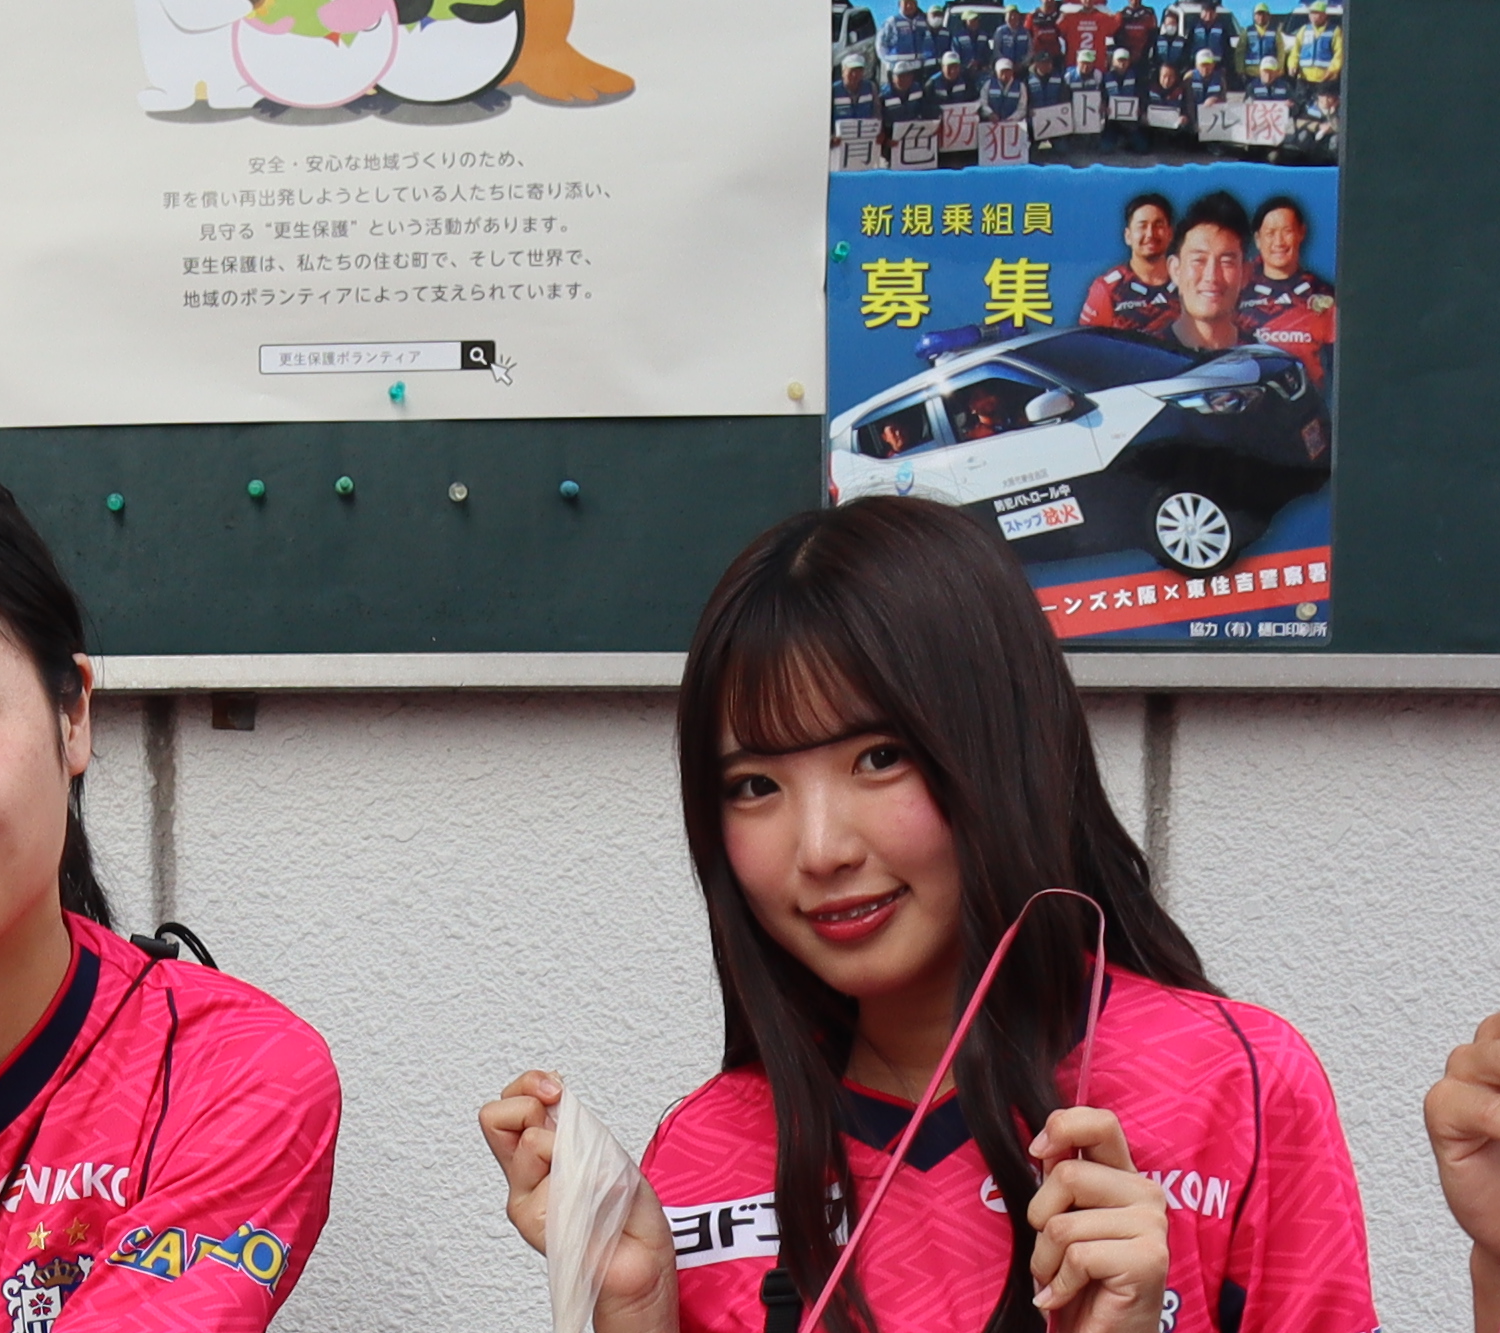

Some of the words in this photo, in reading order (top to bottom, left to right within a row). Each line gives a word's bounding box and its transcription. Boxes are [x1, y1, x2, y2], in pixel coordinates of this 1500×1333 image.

[248, 149, 527, 175] 安全・安心な地域づくりのため、
[162, 180, 613, 210] 罪を償い再出発しようとしている人たちに寄り添い、
[861, 204, 1053, 236] 新規乗組員
[182, 246, 593, 276] 更生保護は、私たちの住む町で、そして世界で、
[182, 281, 594, 309] 地域のボランティアによって支えられています。
[861, 257, 1053, 328] 募集
[279, 348, 422, 366] 更生保護ボランティア
[1004, 503, 1081, 534] ストップ放火
